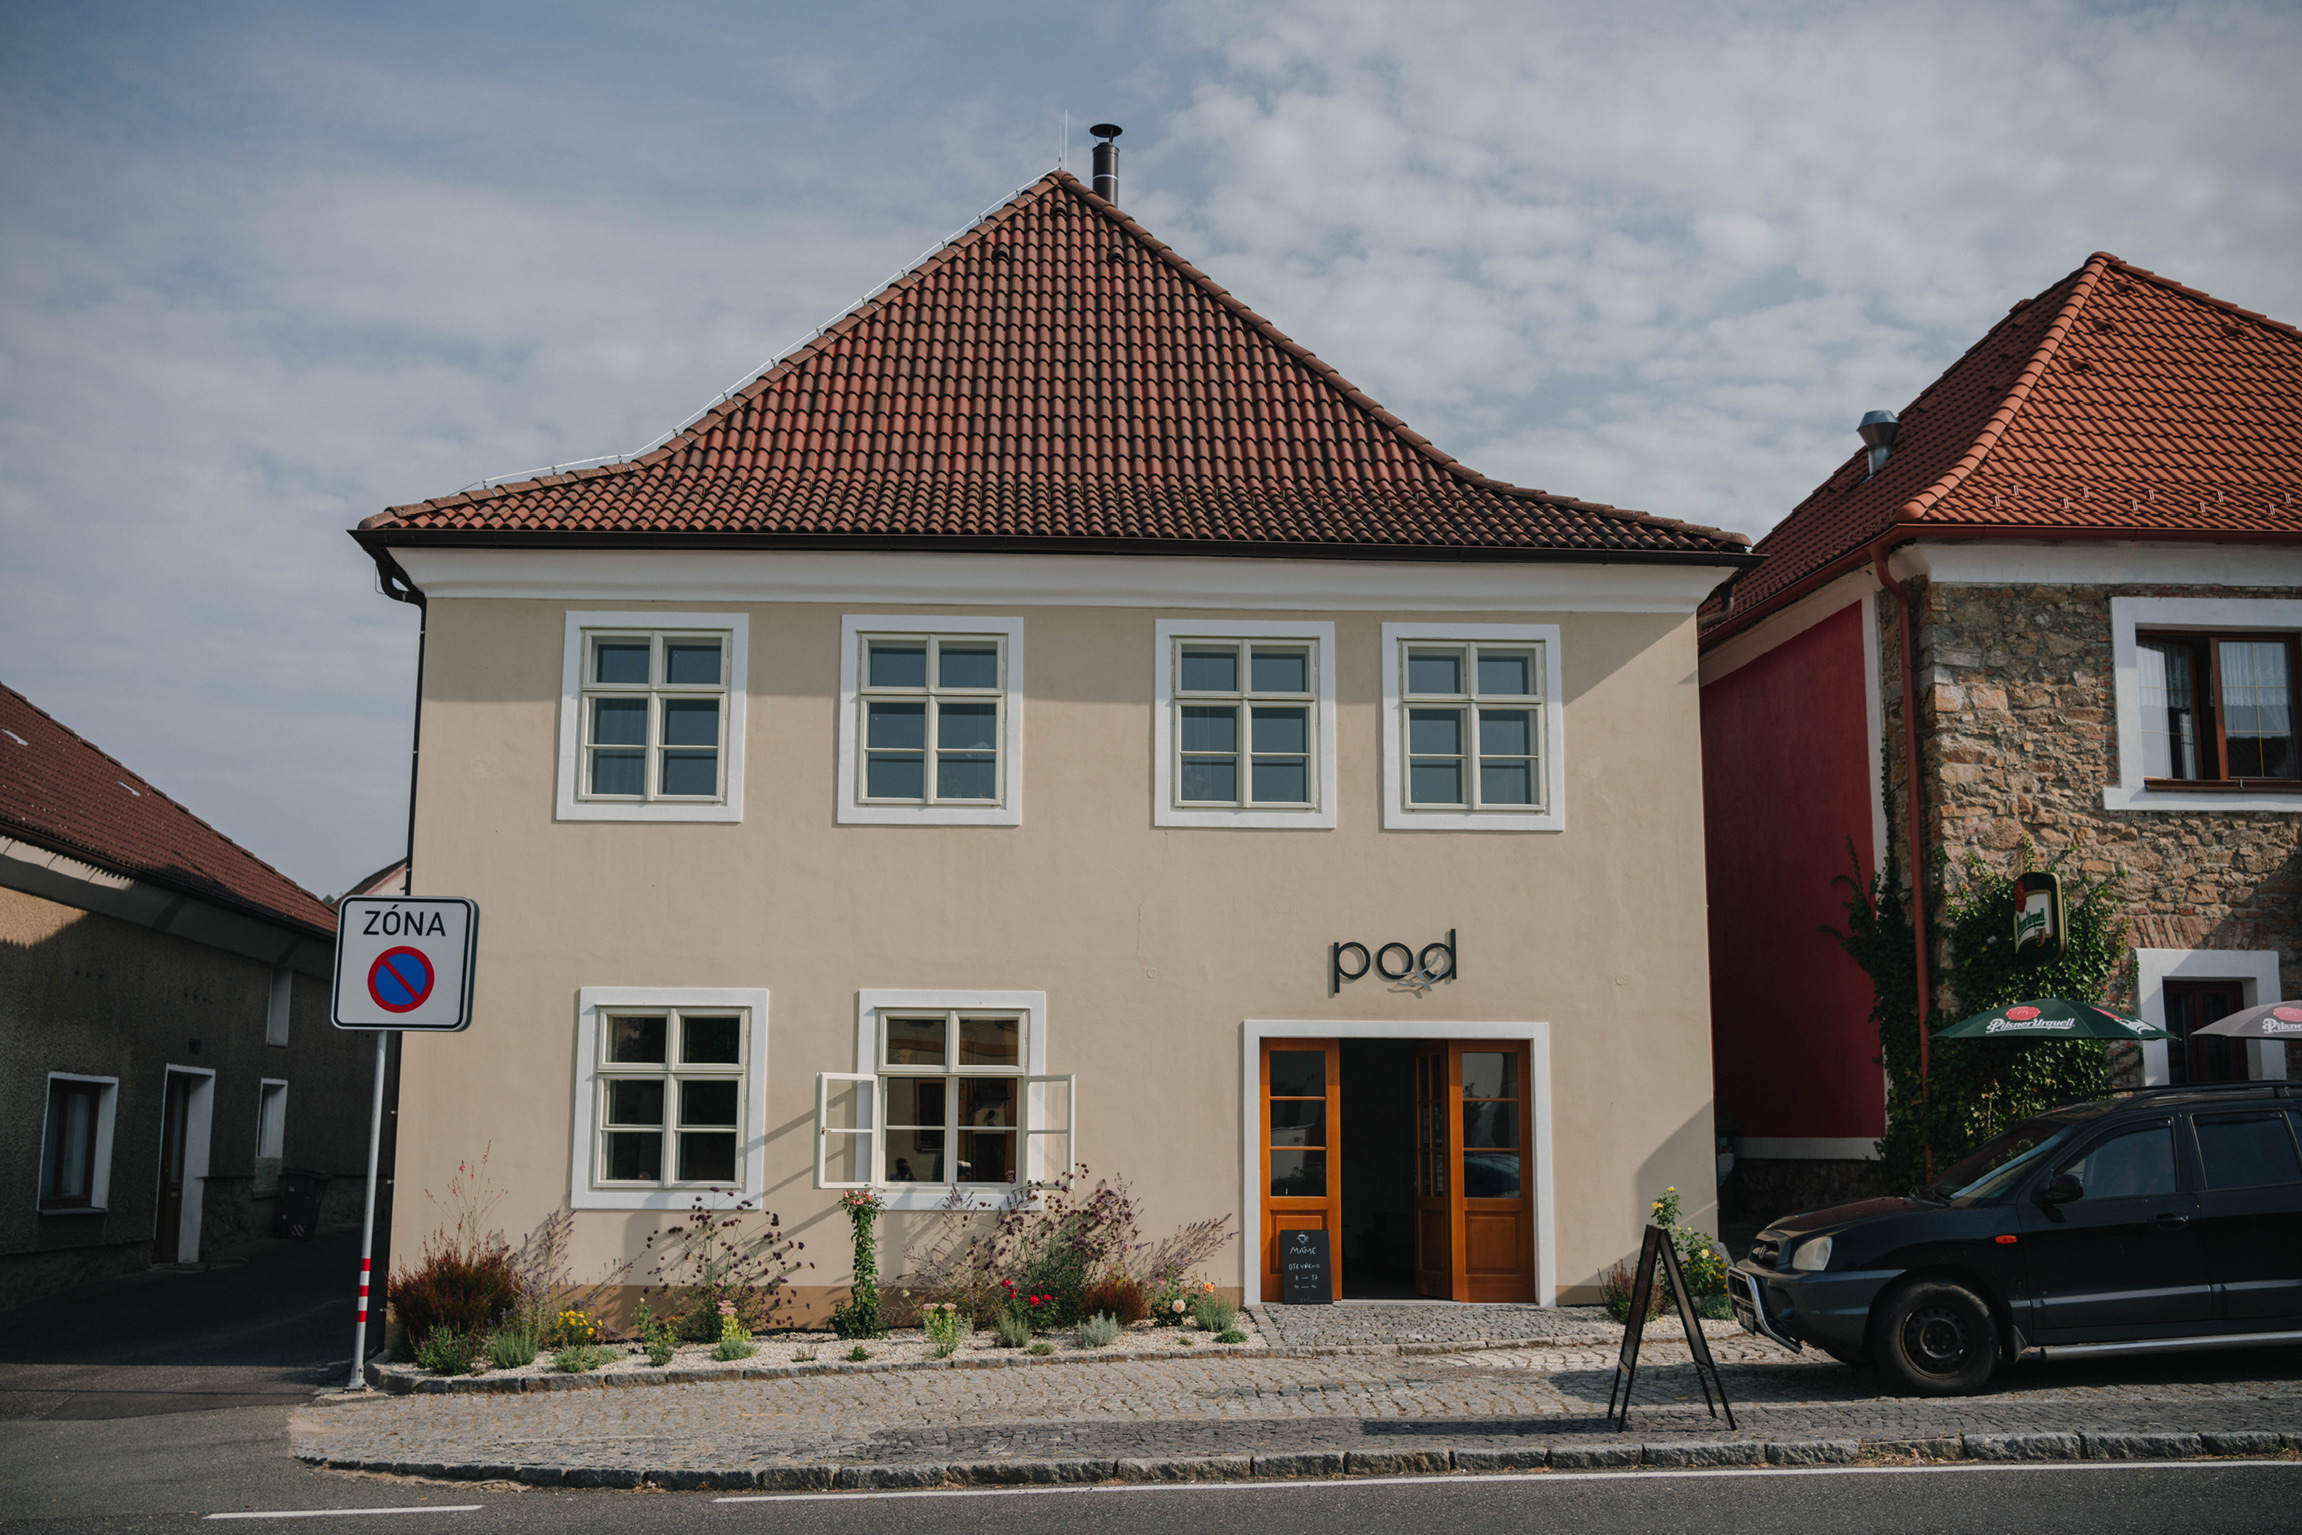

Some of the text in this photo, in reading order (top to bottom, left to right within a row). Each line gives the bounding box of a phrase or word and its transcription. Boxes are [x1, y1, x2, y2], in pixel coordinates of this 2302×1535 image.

[363, 904, 446, 936] ZÓNA
[1333, 928, 1457, 993] pod
[1985, 1018, 2033, 1034] Pilsner
[1289, 1246, 1317, 1255] MÁME
